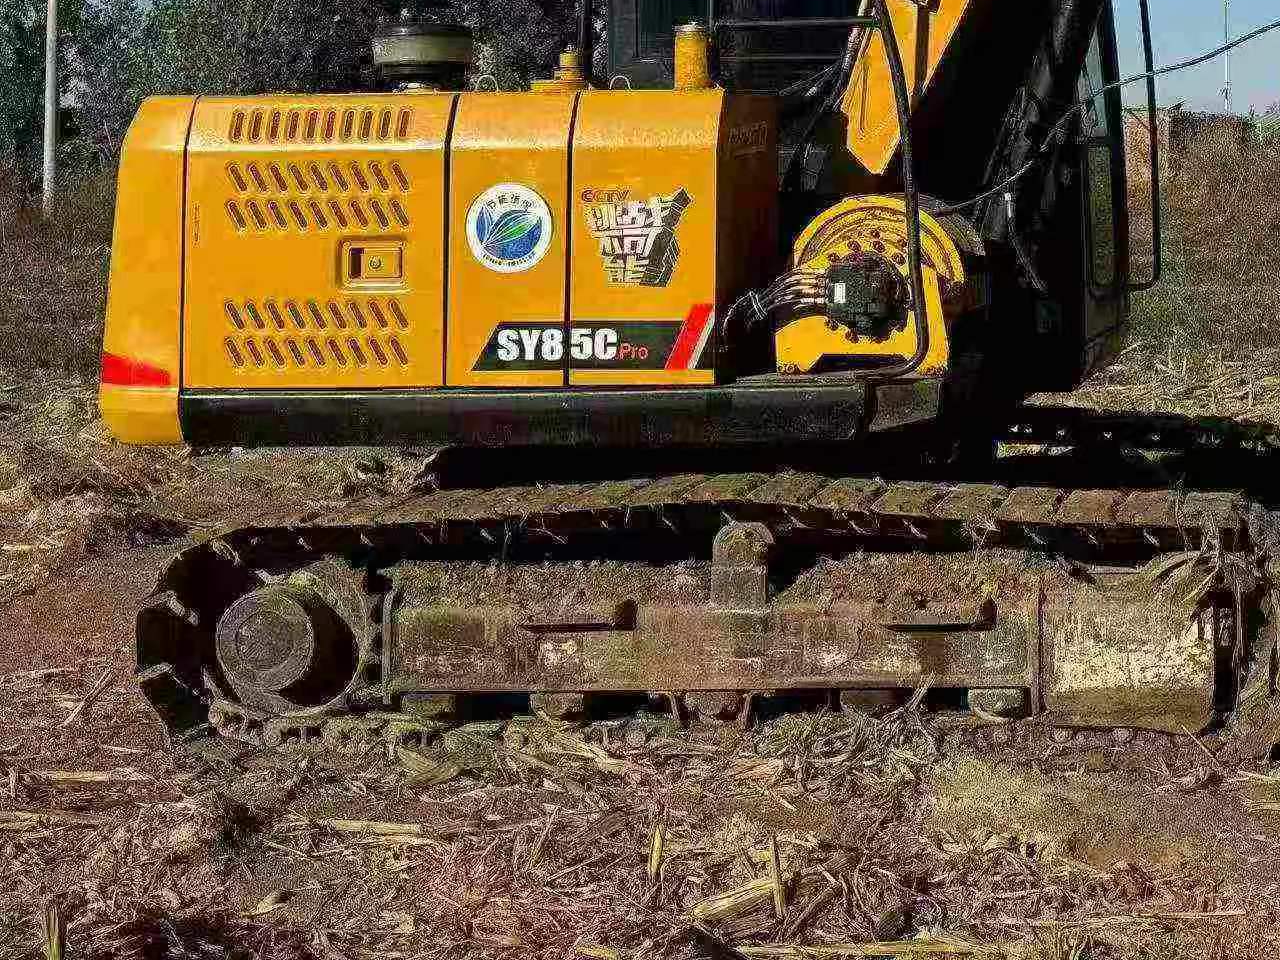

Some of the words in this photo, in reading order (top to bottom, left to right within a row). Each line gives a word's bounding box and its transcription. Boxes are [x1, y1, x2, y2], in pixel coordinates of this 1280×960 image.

[581, 189, 630, 203] CCTV
[497, 327, 619, 361] SY85C
[619, 342, 649, 360] Pro
